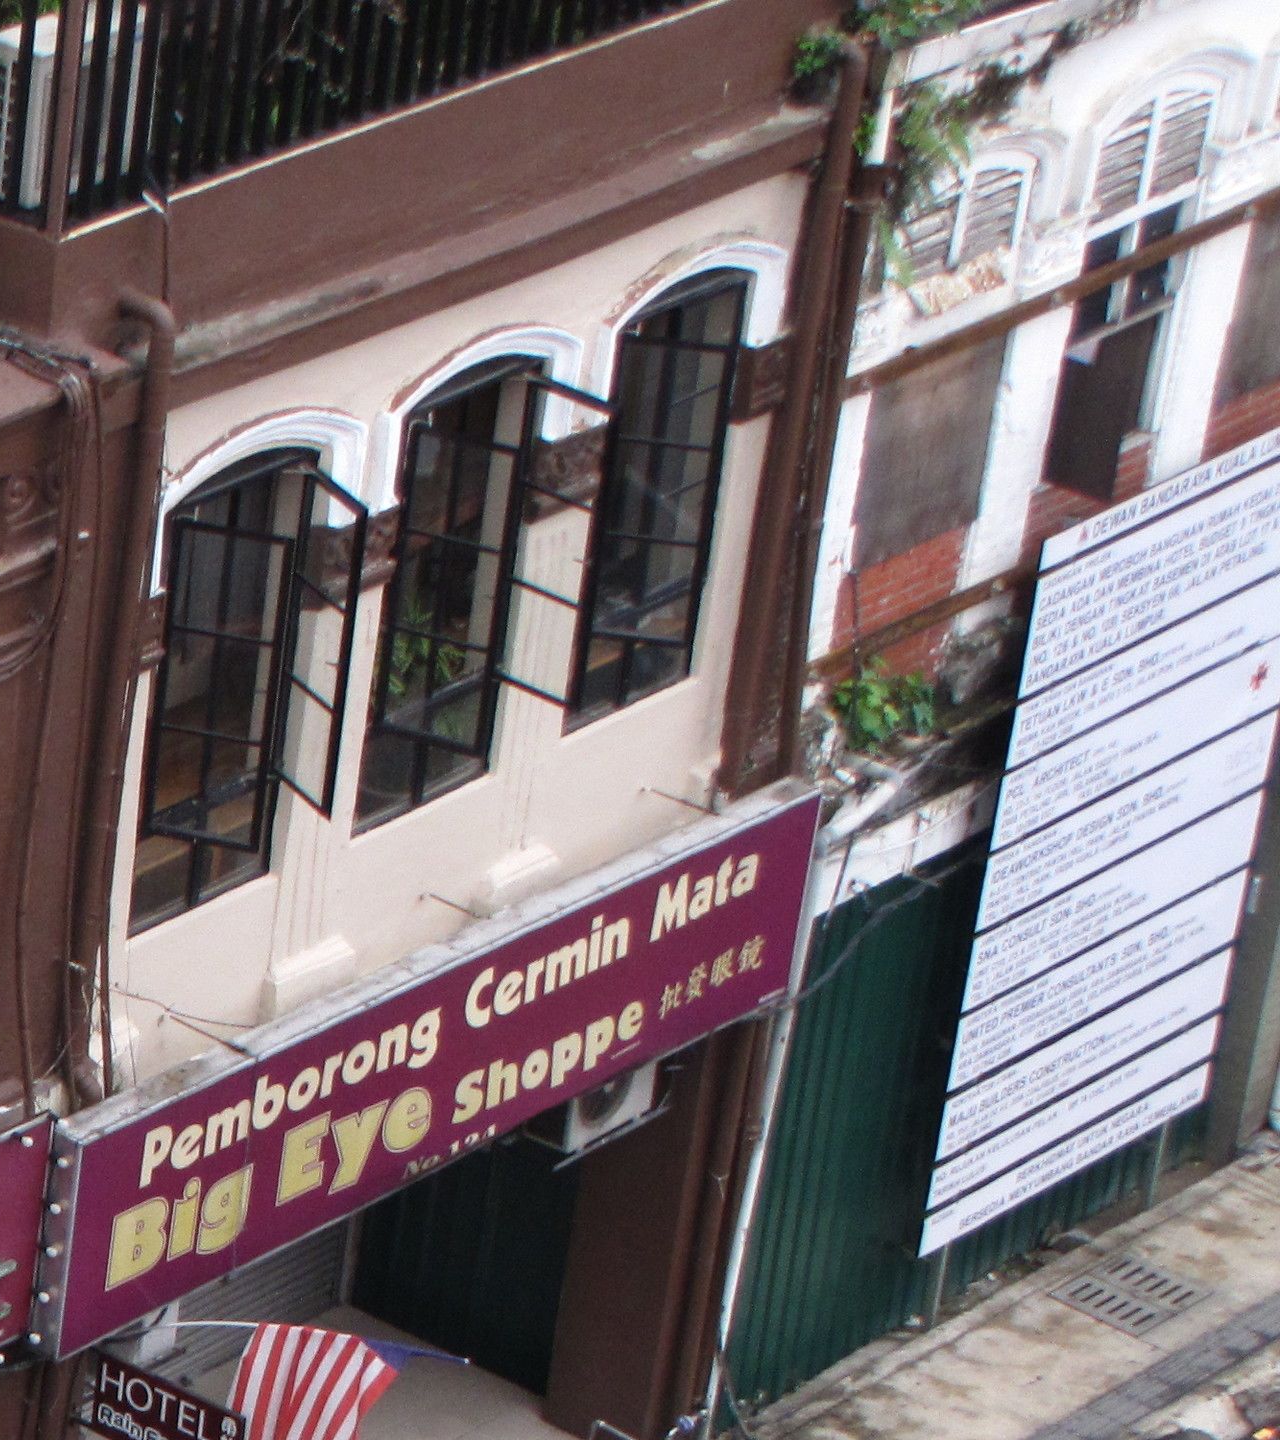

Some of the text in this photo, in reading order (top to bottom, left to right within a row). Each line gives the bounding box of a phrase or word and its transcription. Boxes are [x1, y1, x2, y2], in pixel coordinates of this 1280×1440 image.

[104, 999, 644, 1293] Big Eye Shoppe
[139, 851, 762, 1189] Pemborong Cermin Mata
